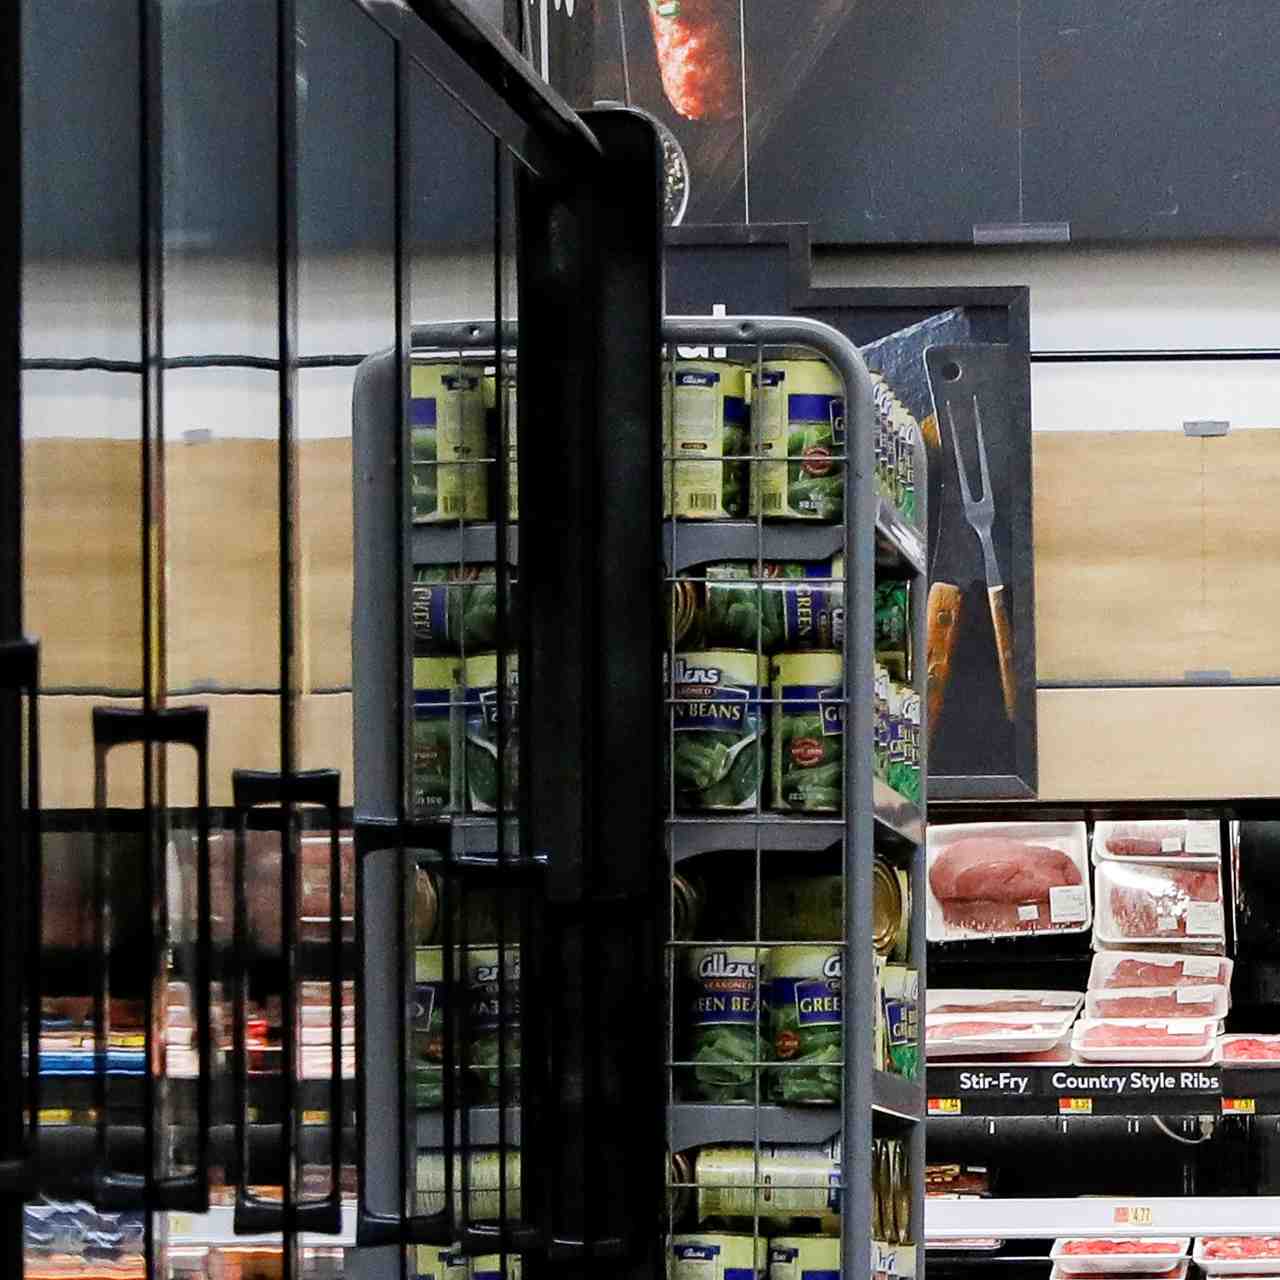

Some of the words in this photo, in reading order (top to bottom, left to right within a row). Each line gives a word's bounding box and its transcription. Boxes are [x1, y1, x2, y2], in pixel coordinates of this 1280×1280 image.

[689, 703, 741, 721] BEANS
[800, 997, 840, 1014] GREE
[959, 1072, 1029, 1095] Stir-Fry
[1052, 1072, 1127, 1095] Country
[1130, 1072, 1176, 1095] Style
[1180, 1072, 1220, 1092] Ribs
